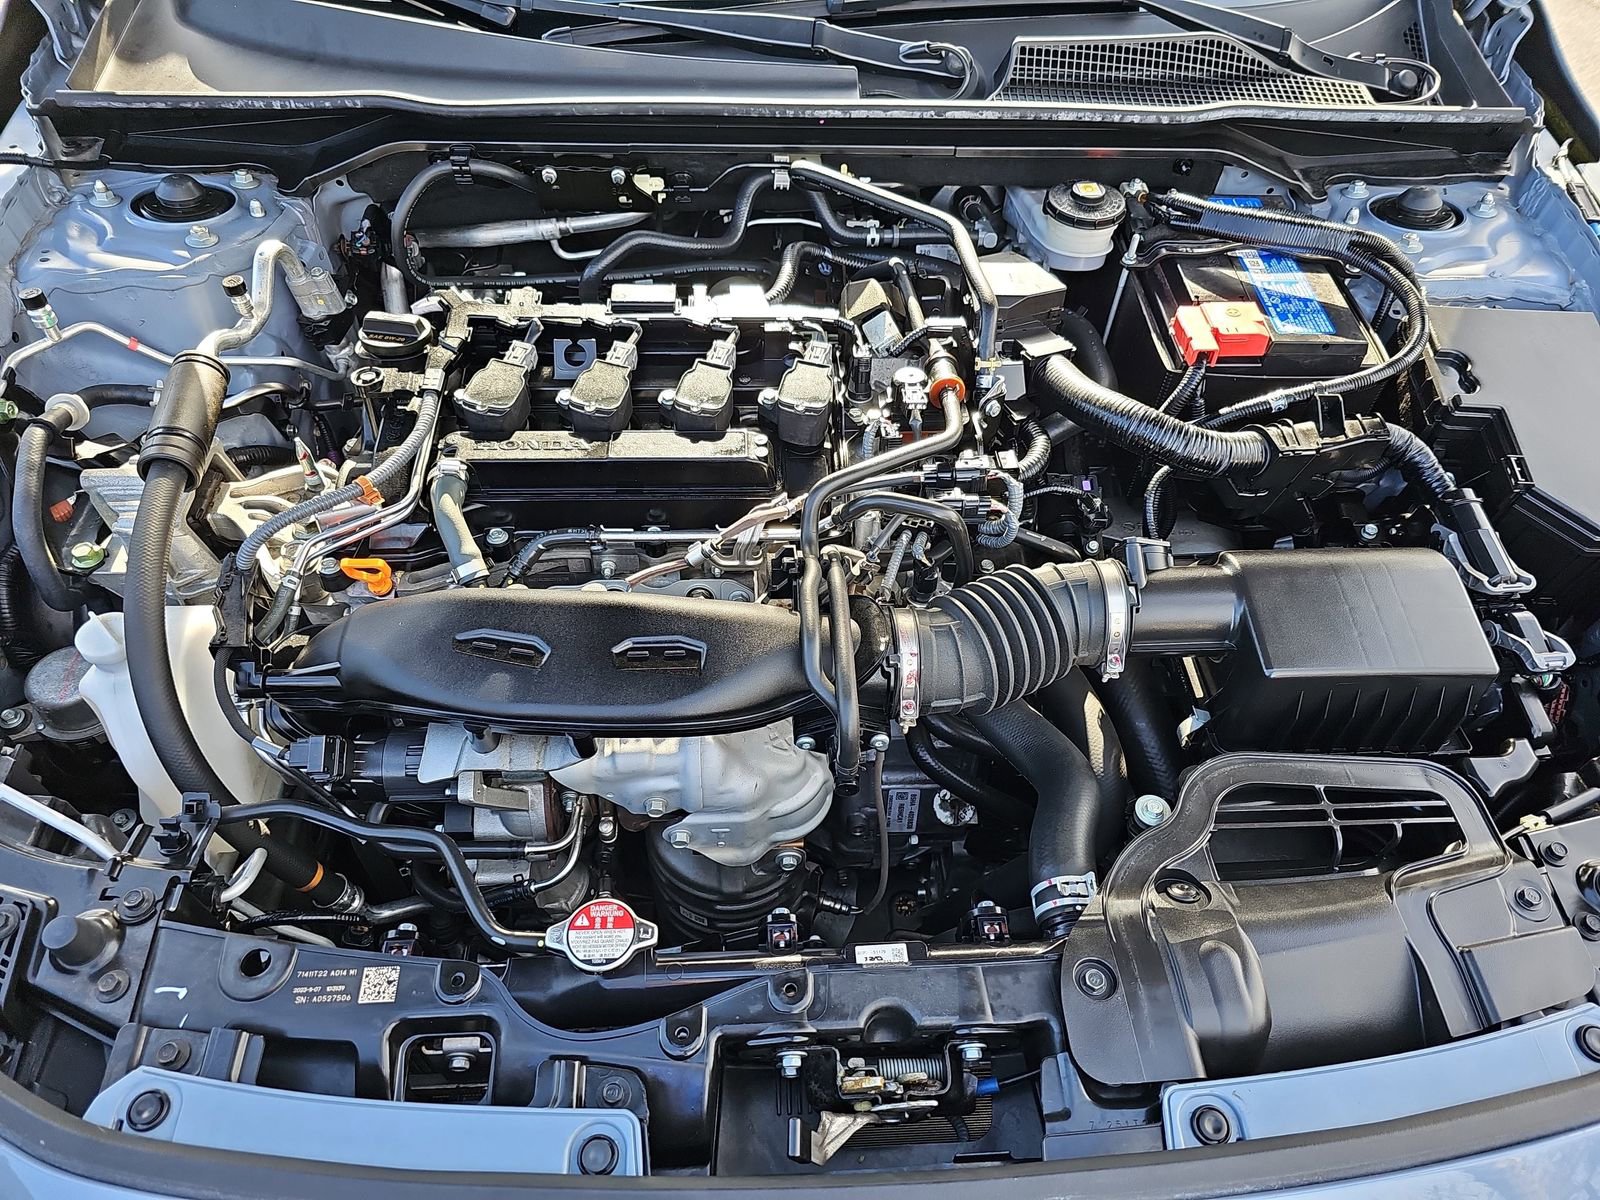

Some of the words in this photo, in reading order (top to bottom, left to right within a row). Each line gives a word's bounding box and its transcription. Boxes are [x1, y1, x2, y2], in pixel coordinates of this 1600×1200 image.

[473, 439, 592, 451] HONDA
[297, 970, 328, 978] 71411T22
[294, 995, 310, 1004] SN:
[311, 994, 352, 1003] A0527506
